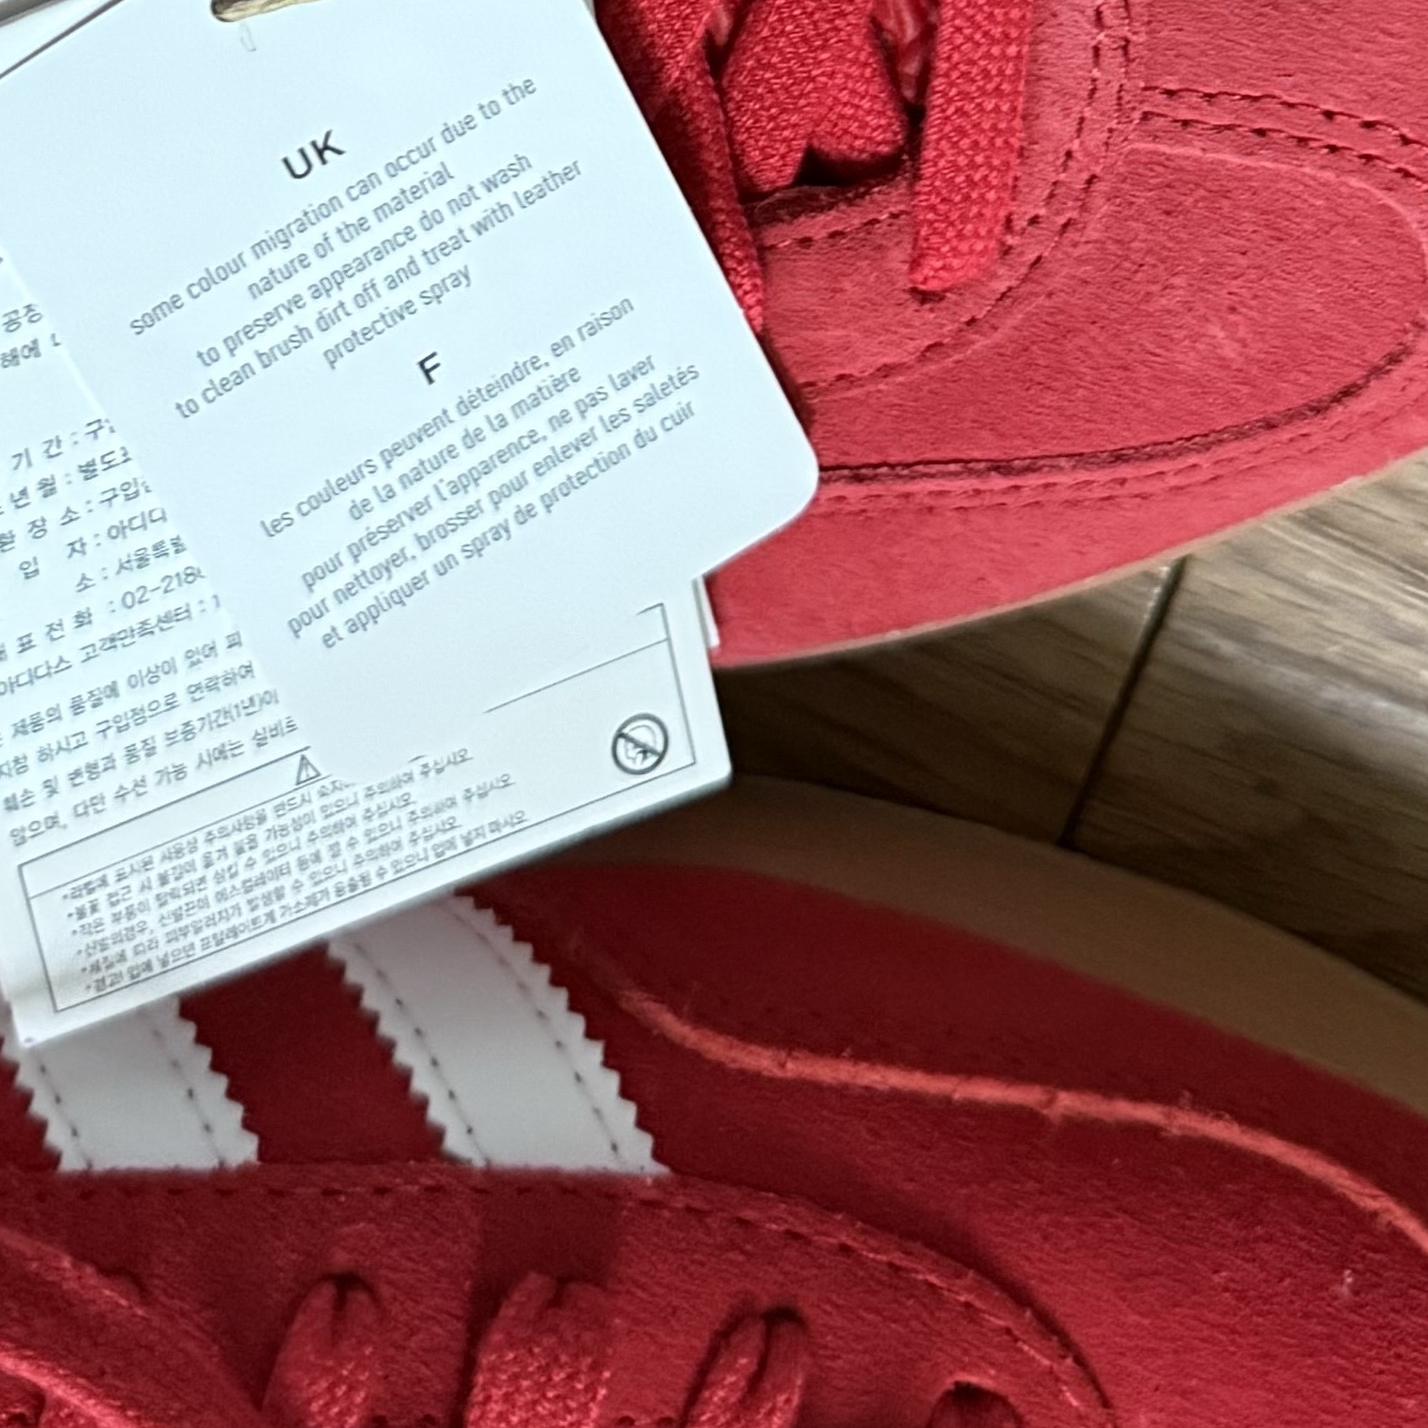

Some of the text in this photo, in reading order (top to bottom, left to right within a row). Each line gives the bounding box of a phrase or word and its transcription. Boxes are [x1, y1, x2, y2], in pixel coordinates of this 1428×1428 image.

[130, 79, 536, 335] some colour migration can occur due to the
[281, 130, 346, 179] UK
[176, 161, 580, 418] to clean brush dirt off and treat with leather
[197, 154, 532, 366] to preserve appearance do not wash
[248, 162, 454, 299] nature of the material
[323, 265, 470, 369] protective spray
[417, 352, 441, 385] F
[261, 299, 634, 537] les couleurs peuvent déteindre, en raison
[302, 552, 343, 593] pour
[347, 496, 432, 563] préserver
[548, 409, 572, 431] ne
[575, 386, 608, 419] pas
[608, 356, 654, 391] laver
[349, 368, 581, 520] de la nature de la matière
[288, 365, 699, 638] pour nettoyer, brosser pour enlever les saletés
[323, 402, 694, 648] et appliquer un spray de protection du cuir
[12, 704, 62, 737] 제품의
[70, 681, 119, 716] 품질에
[128, 658, 177, 689] 이상이
[185, 642, 217, 668] 있어
[80, 603, 191, 663] 고객만족센터
[38, 731, 88, 762] 하시고
[96, 692, 180, 739] 구입점으로
[155, 764, 187, 784] 가능
